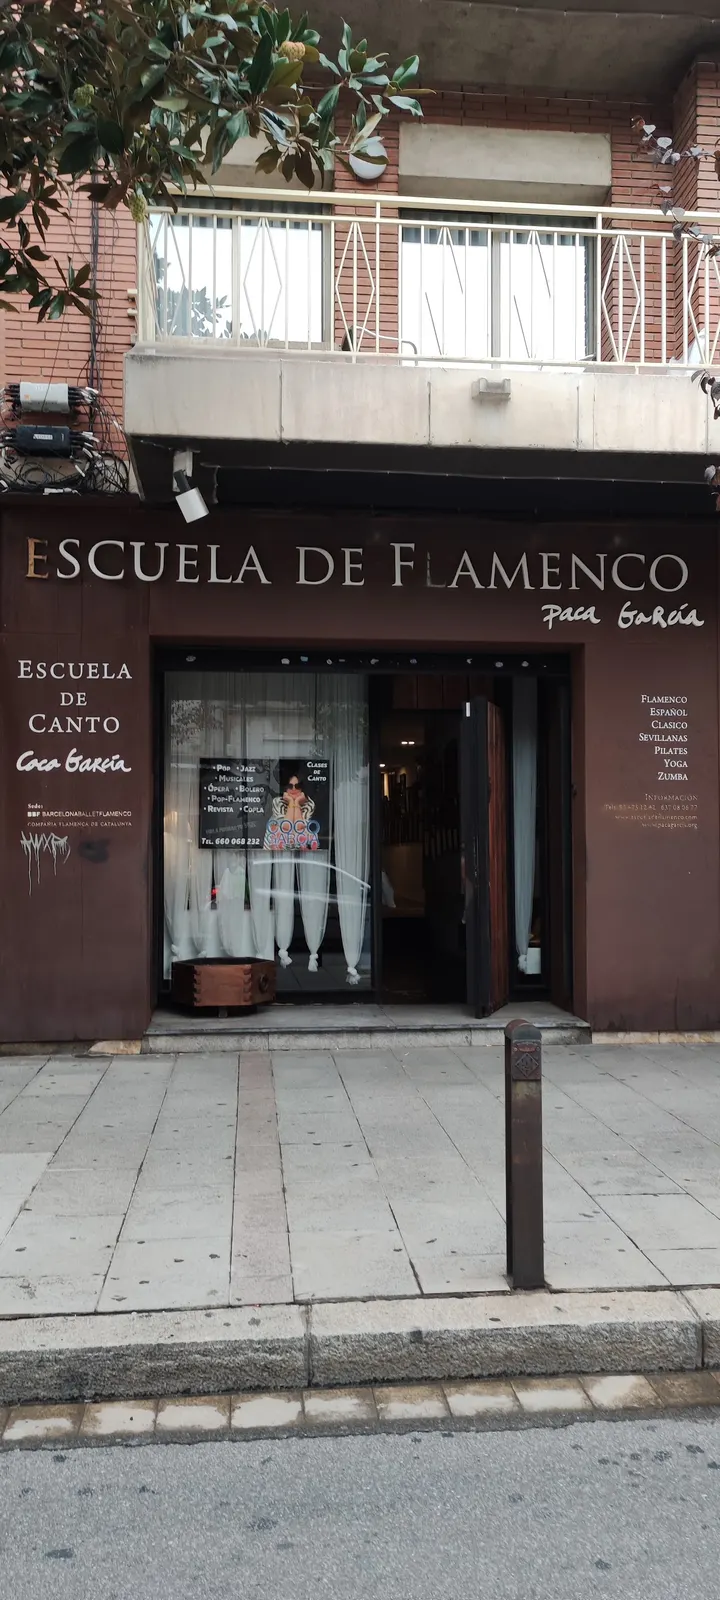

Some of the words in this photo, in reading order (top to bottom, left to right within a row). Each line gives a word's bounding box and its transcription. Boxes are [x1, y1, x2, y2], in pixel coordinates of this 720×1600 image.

[25, 536, 272, 585] ESCUELA
[296, 546, 364, 586] DE
[17, 660, 133, 679] ESCUELA
[60, 692, 87, 706] DE
[641, 694, 688, 704] FLAMENCO
[650, 707, 688, 717] ESPAÑOL
[28, 714, 120, 733] CANTO
[651, 720, 688, 729] CLASICO
[639, 733, 688, 742] SEVILLANAS
[654, 746, 688, 755] PILATES
[306, 761, 328, 769] CLASES
[664, 759, 688, 768] YOGA
[218, 774, 254, 783] MUSICALES
[657, 772, 688, 781] ZUMBA
